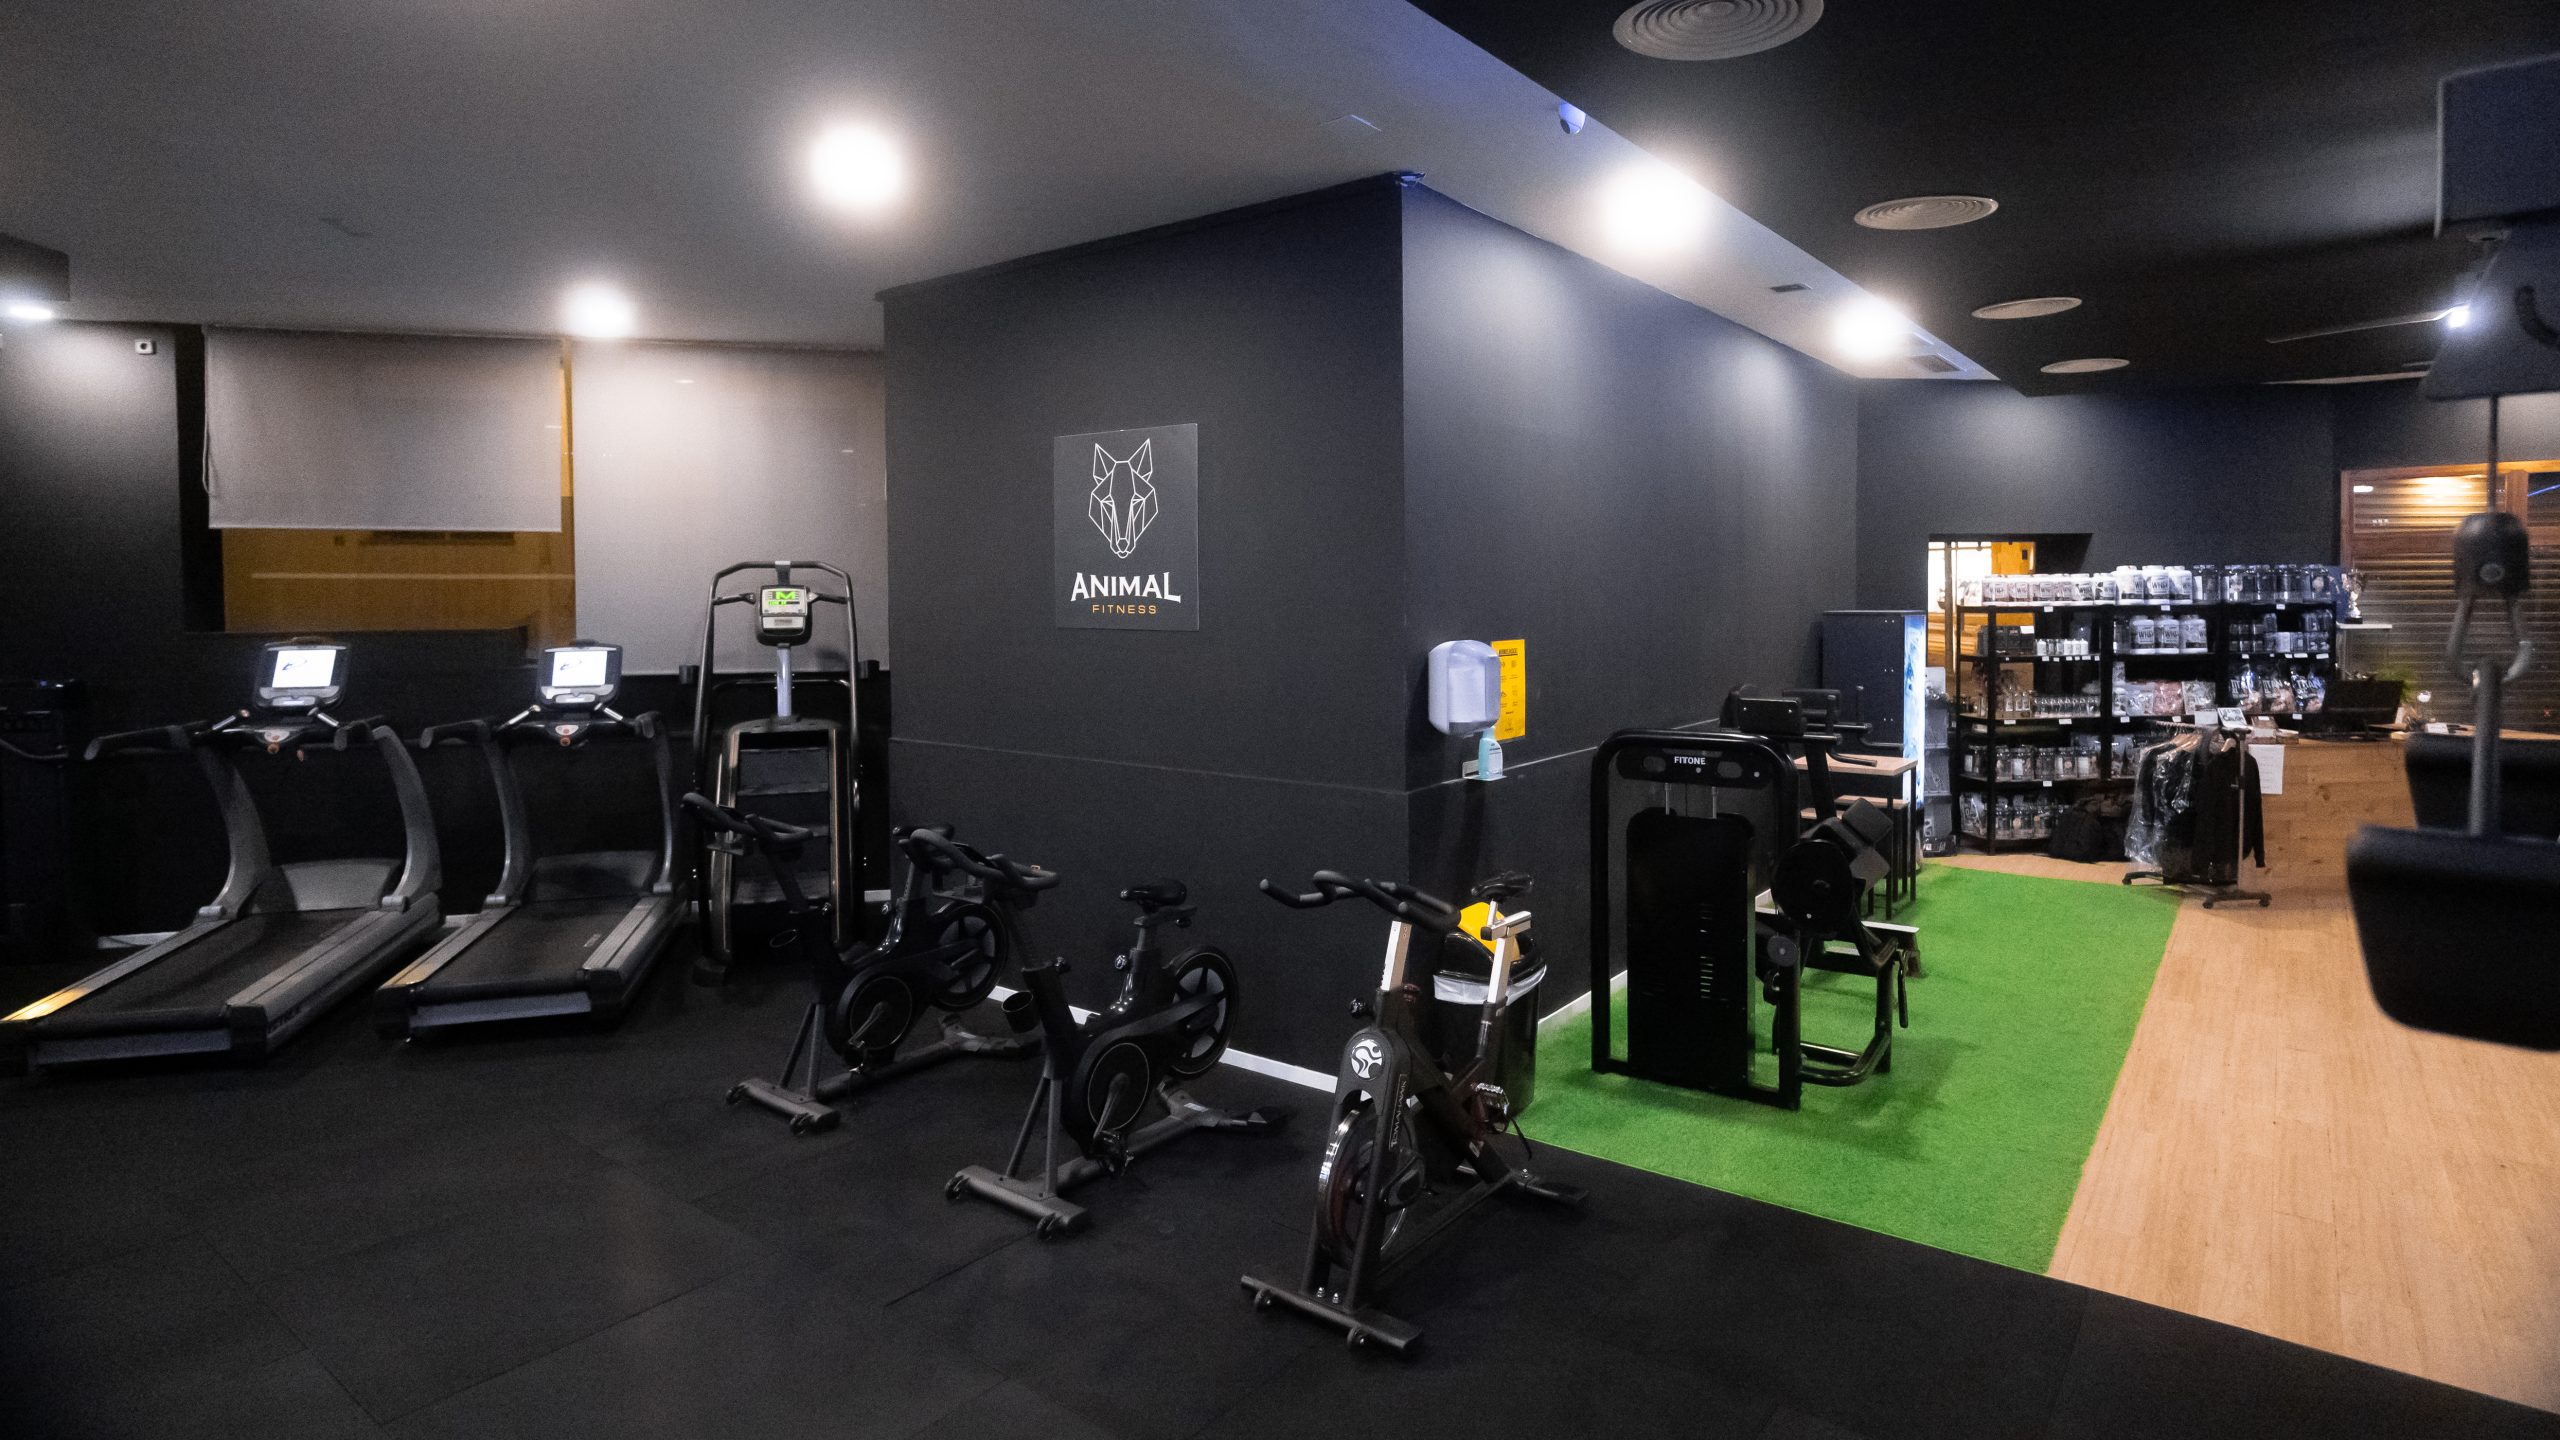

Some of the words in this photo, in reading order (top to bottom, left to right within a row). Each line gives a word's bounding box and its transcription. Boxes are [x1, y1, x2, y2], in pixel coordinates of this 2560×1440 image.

[1070, 571, 1181, 604] ANIMAL
[1092, 604, 1158, 615] FITNESS
[1674, 756, 1706, 765] FITONE
